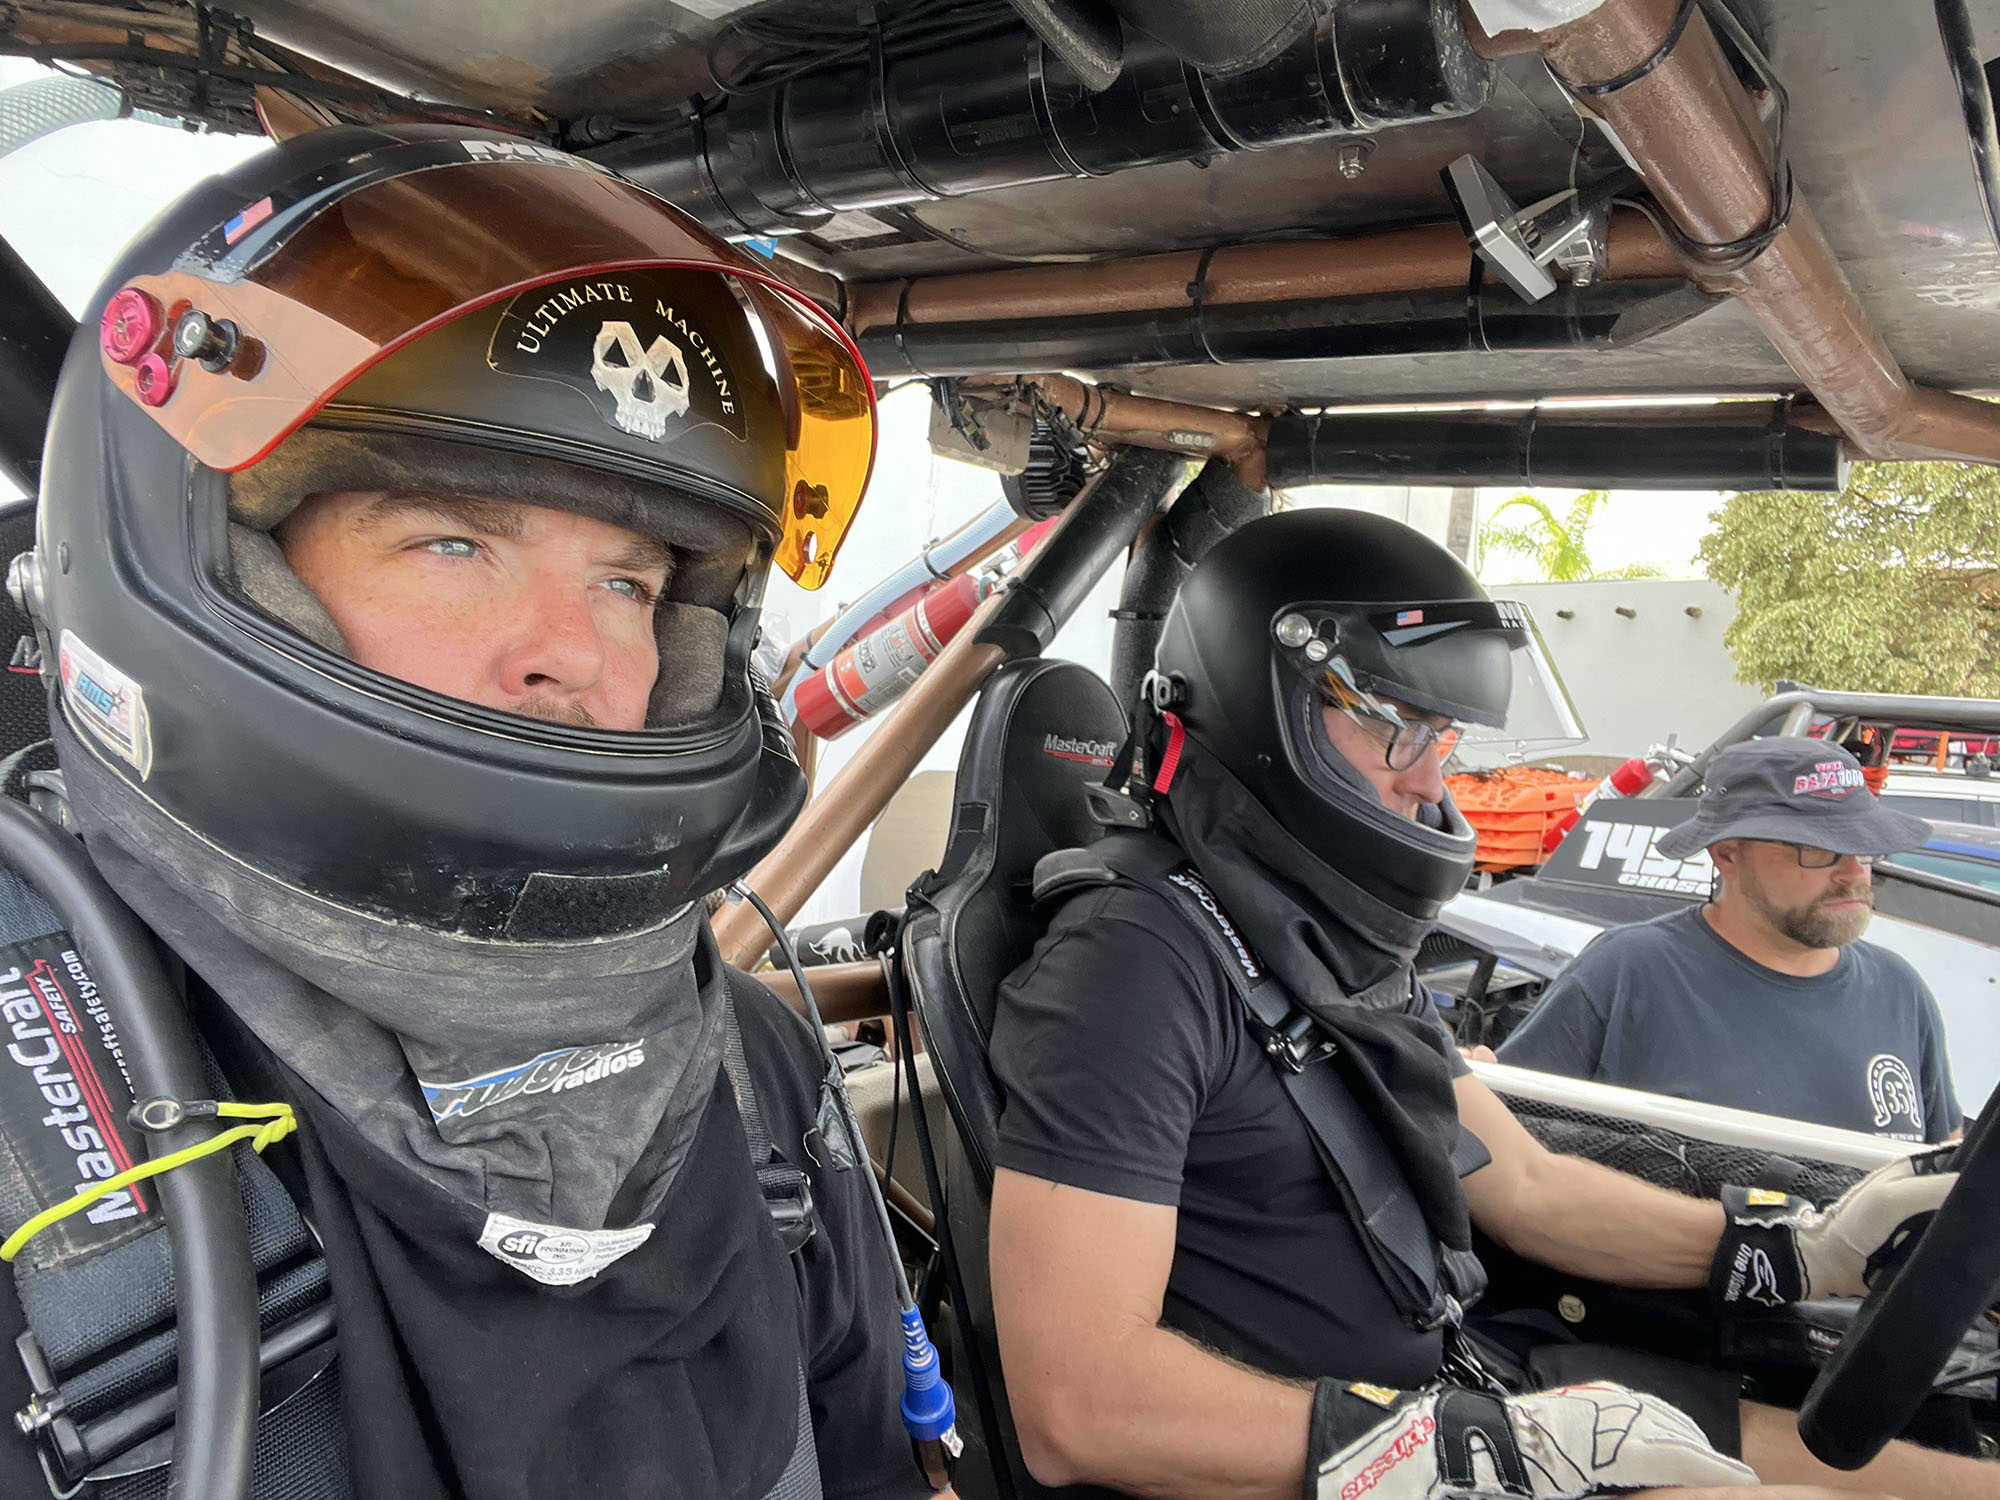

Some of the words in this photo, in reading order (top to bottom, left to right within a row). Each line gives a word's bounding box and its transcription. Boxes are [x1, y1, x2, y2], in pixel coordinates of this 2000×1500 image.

[516, 283, 633, 354] ULTIMATE
[656, 299, 735, 416] MACHINE
[1044, 733, 1117, 757] MasterCraft
[35, 975, 78, 1035] SAFETY
[551, 1048, 645, 1094] radios
[1885, 1080, 1910, 1115] 35
[502, 1234, 539, 1255] sfi
